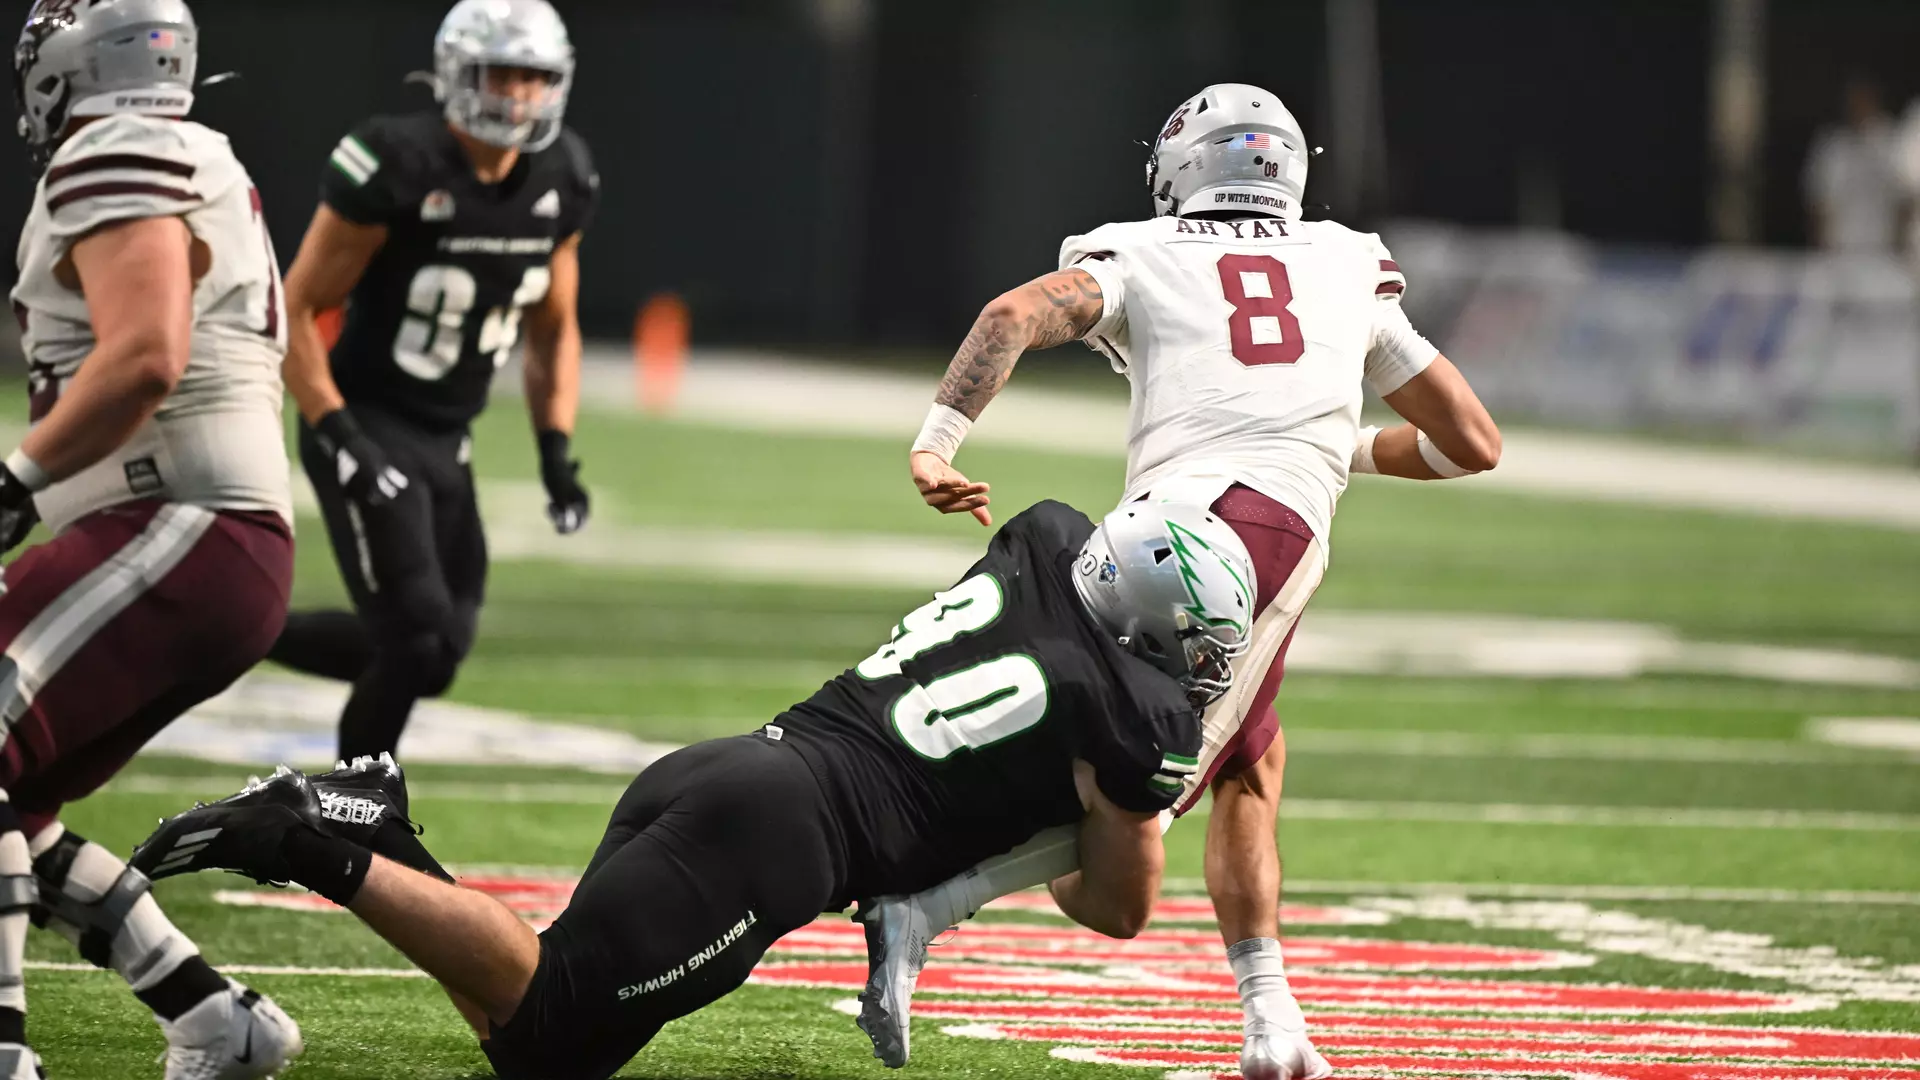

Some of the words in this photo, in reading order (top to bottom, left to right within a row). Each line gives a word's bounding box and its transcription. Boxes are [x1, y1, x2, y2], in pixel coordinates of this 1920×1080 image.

[1264, 161, 1279, 178] 08
[1214, 193, 1226, 203] UP
[1227, 193, 1250, 204] WITH
[1251, 194, 1287, 211] MONTANA
[1215, 252, 1306, 368] 8
[617, 964, 685, 1000] HAWKS
